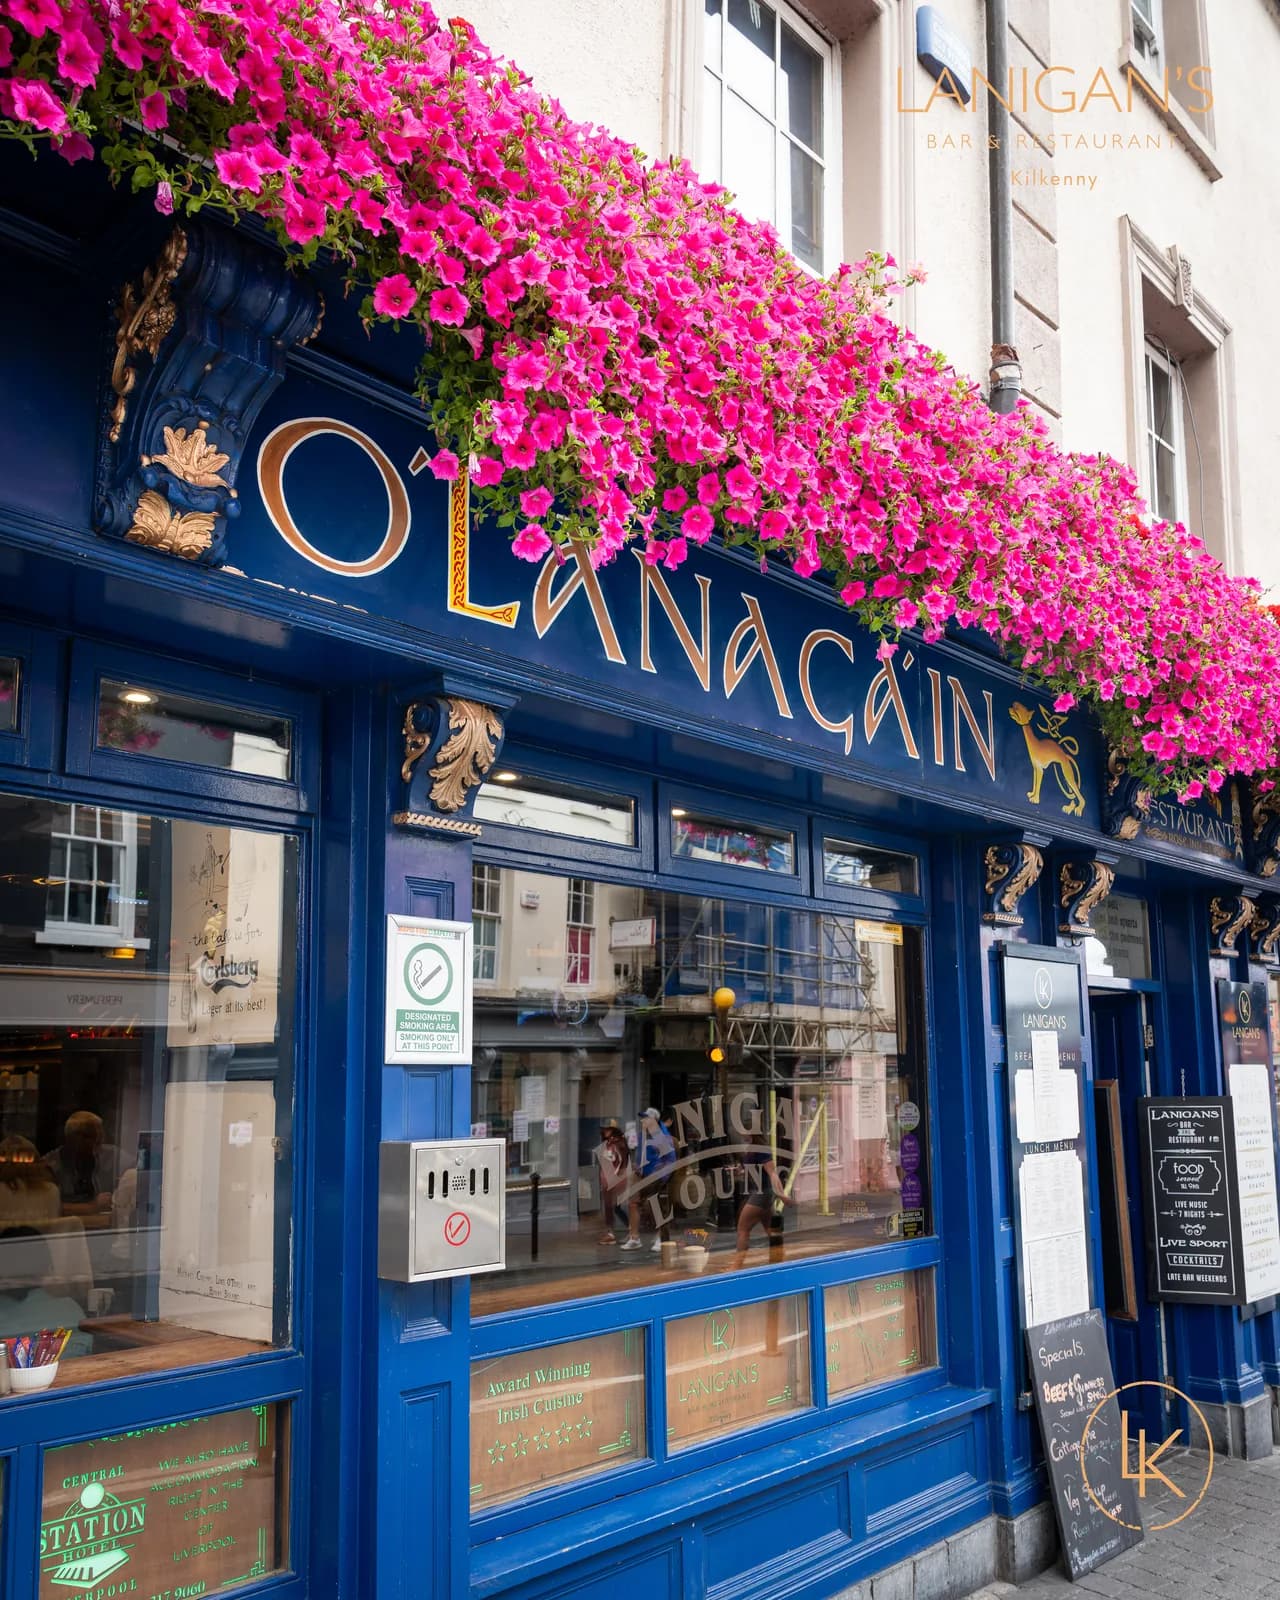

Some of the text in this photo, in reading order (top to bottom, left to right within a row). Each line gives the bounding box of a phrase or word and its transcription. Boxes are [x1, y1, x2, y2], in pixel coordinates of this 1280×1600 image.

[404, 1012, 452, 1022] DESIGNATED
[399, 1021, 457, 1031] SMOKING AREA
[399, 1033, 456, 1043] SMOKING ONLY
[401, 1042, 454, 1051] AT THIS POINT
[1151, 1110, 1220, 1121] LANIGANS
[1179, 1121, 1192, 1129] BAR
[1024, 1140, 1075, 1155] LUNCH MENU
[1168, 1136, 1205, 1144] RESTAURANT
[1174, 1200, 1208, 1209] LIVE MUSIC
[1172, 1255, 1218, 1265] COCKTAILS
[1167, 1272, 1181, 1281] LATE
[1196, 1274, 1228, 1284] WEEKENDS
[485, 1360, 592, 1399] Award Winning
[496, 1391, 585, 1426] Irish Cuisine
[158, 1441, 250, 1472] WE ALSO HAVE
[1050, 1437, 1083, 1462] Cottag
[62, 1465, 125, 1490] CENTRAL
[207, 1484, 218, 1496] IN
[221, 1477, 244, 1490] THE
[1063, 1484, 1081, 1516] Veg
[1081, 1484, 1107, 1505] Sup
[40, 1503, 147, 1555] STATION
[197, 1522, 214, 1537] OF
[62, 1538, 121, 1564] HOTEL
